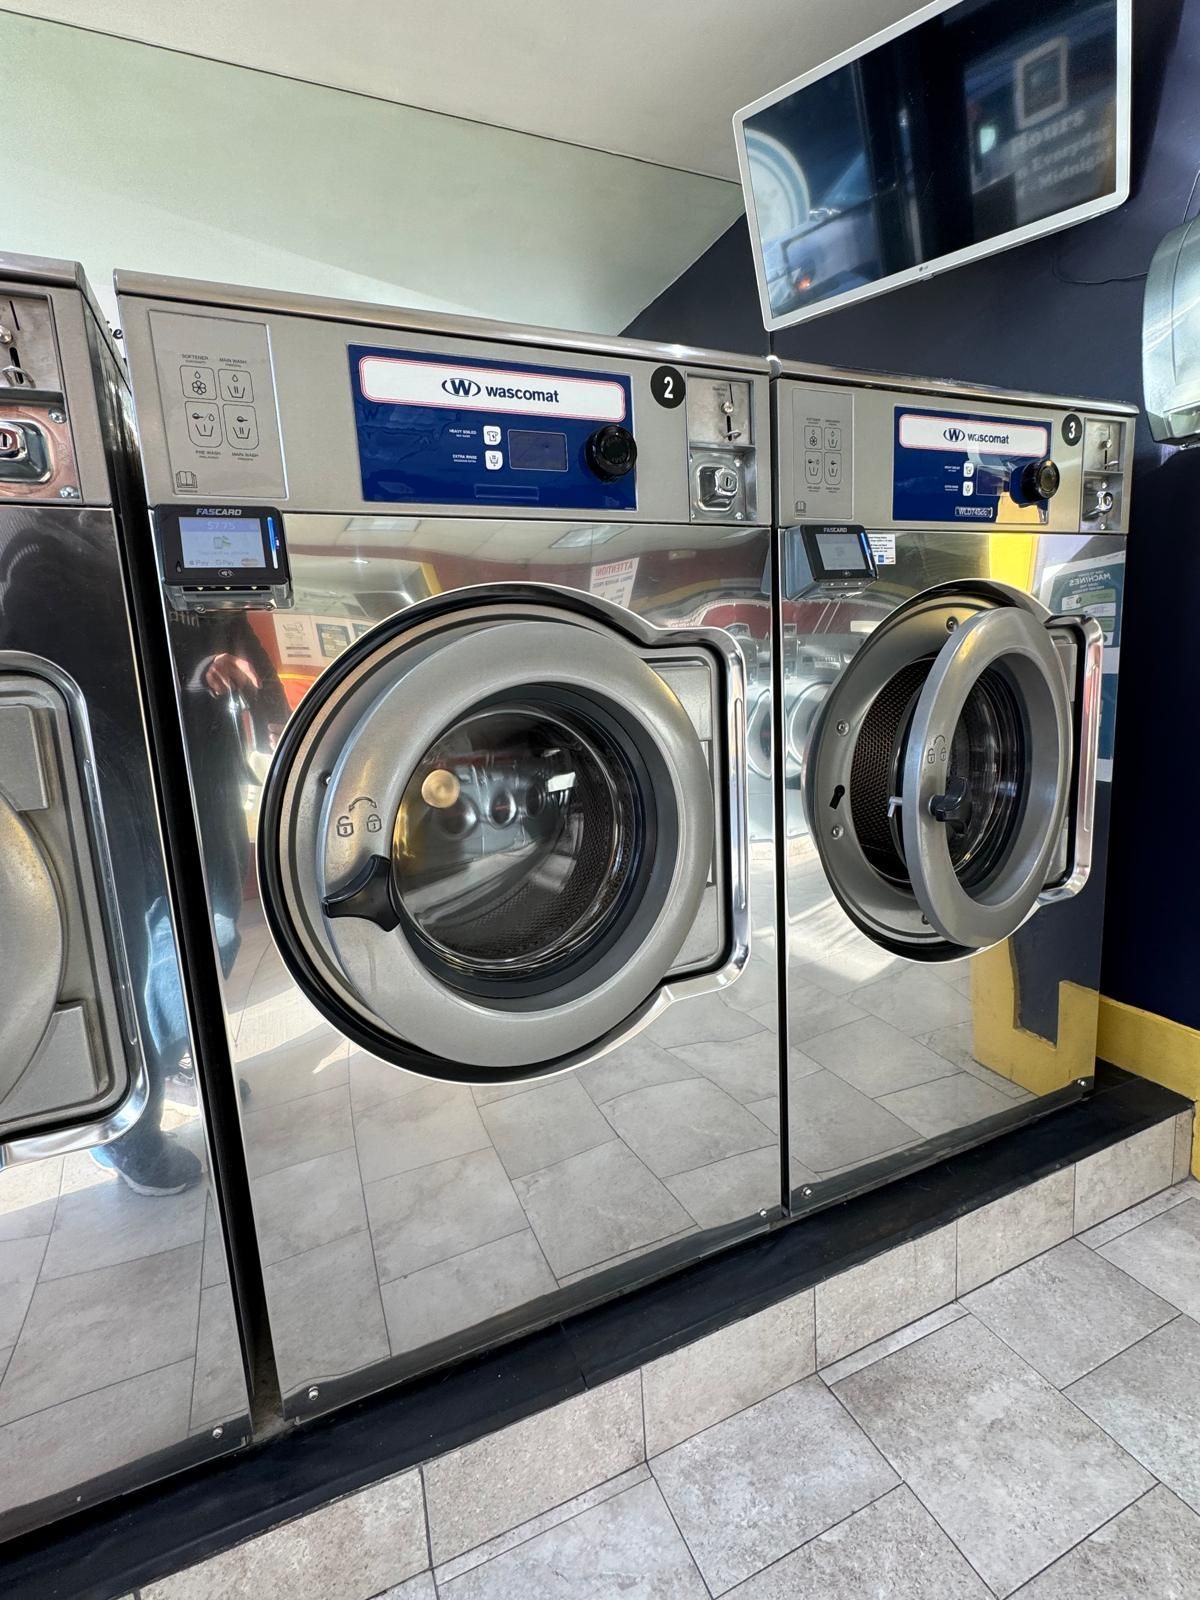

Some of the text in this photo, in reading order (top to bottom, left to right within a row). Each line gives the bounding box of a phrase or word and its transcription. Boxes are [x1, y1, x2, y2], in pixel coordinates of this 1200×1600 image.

[485, 386, 560, 403] wascomat
[664, 376, 674, 399] 2
[967, 432, 1010, 445] wascomat
[1068, 421, 1076, 439] 3
[196, 508, 242, 516] FASCARD
